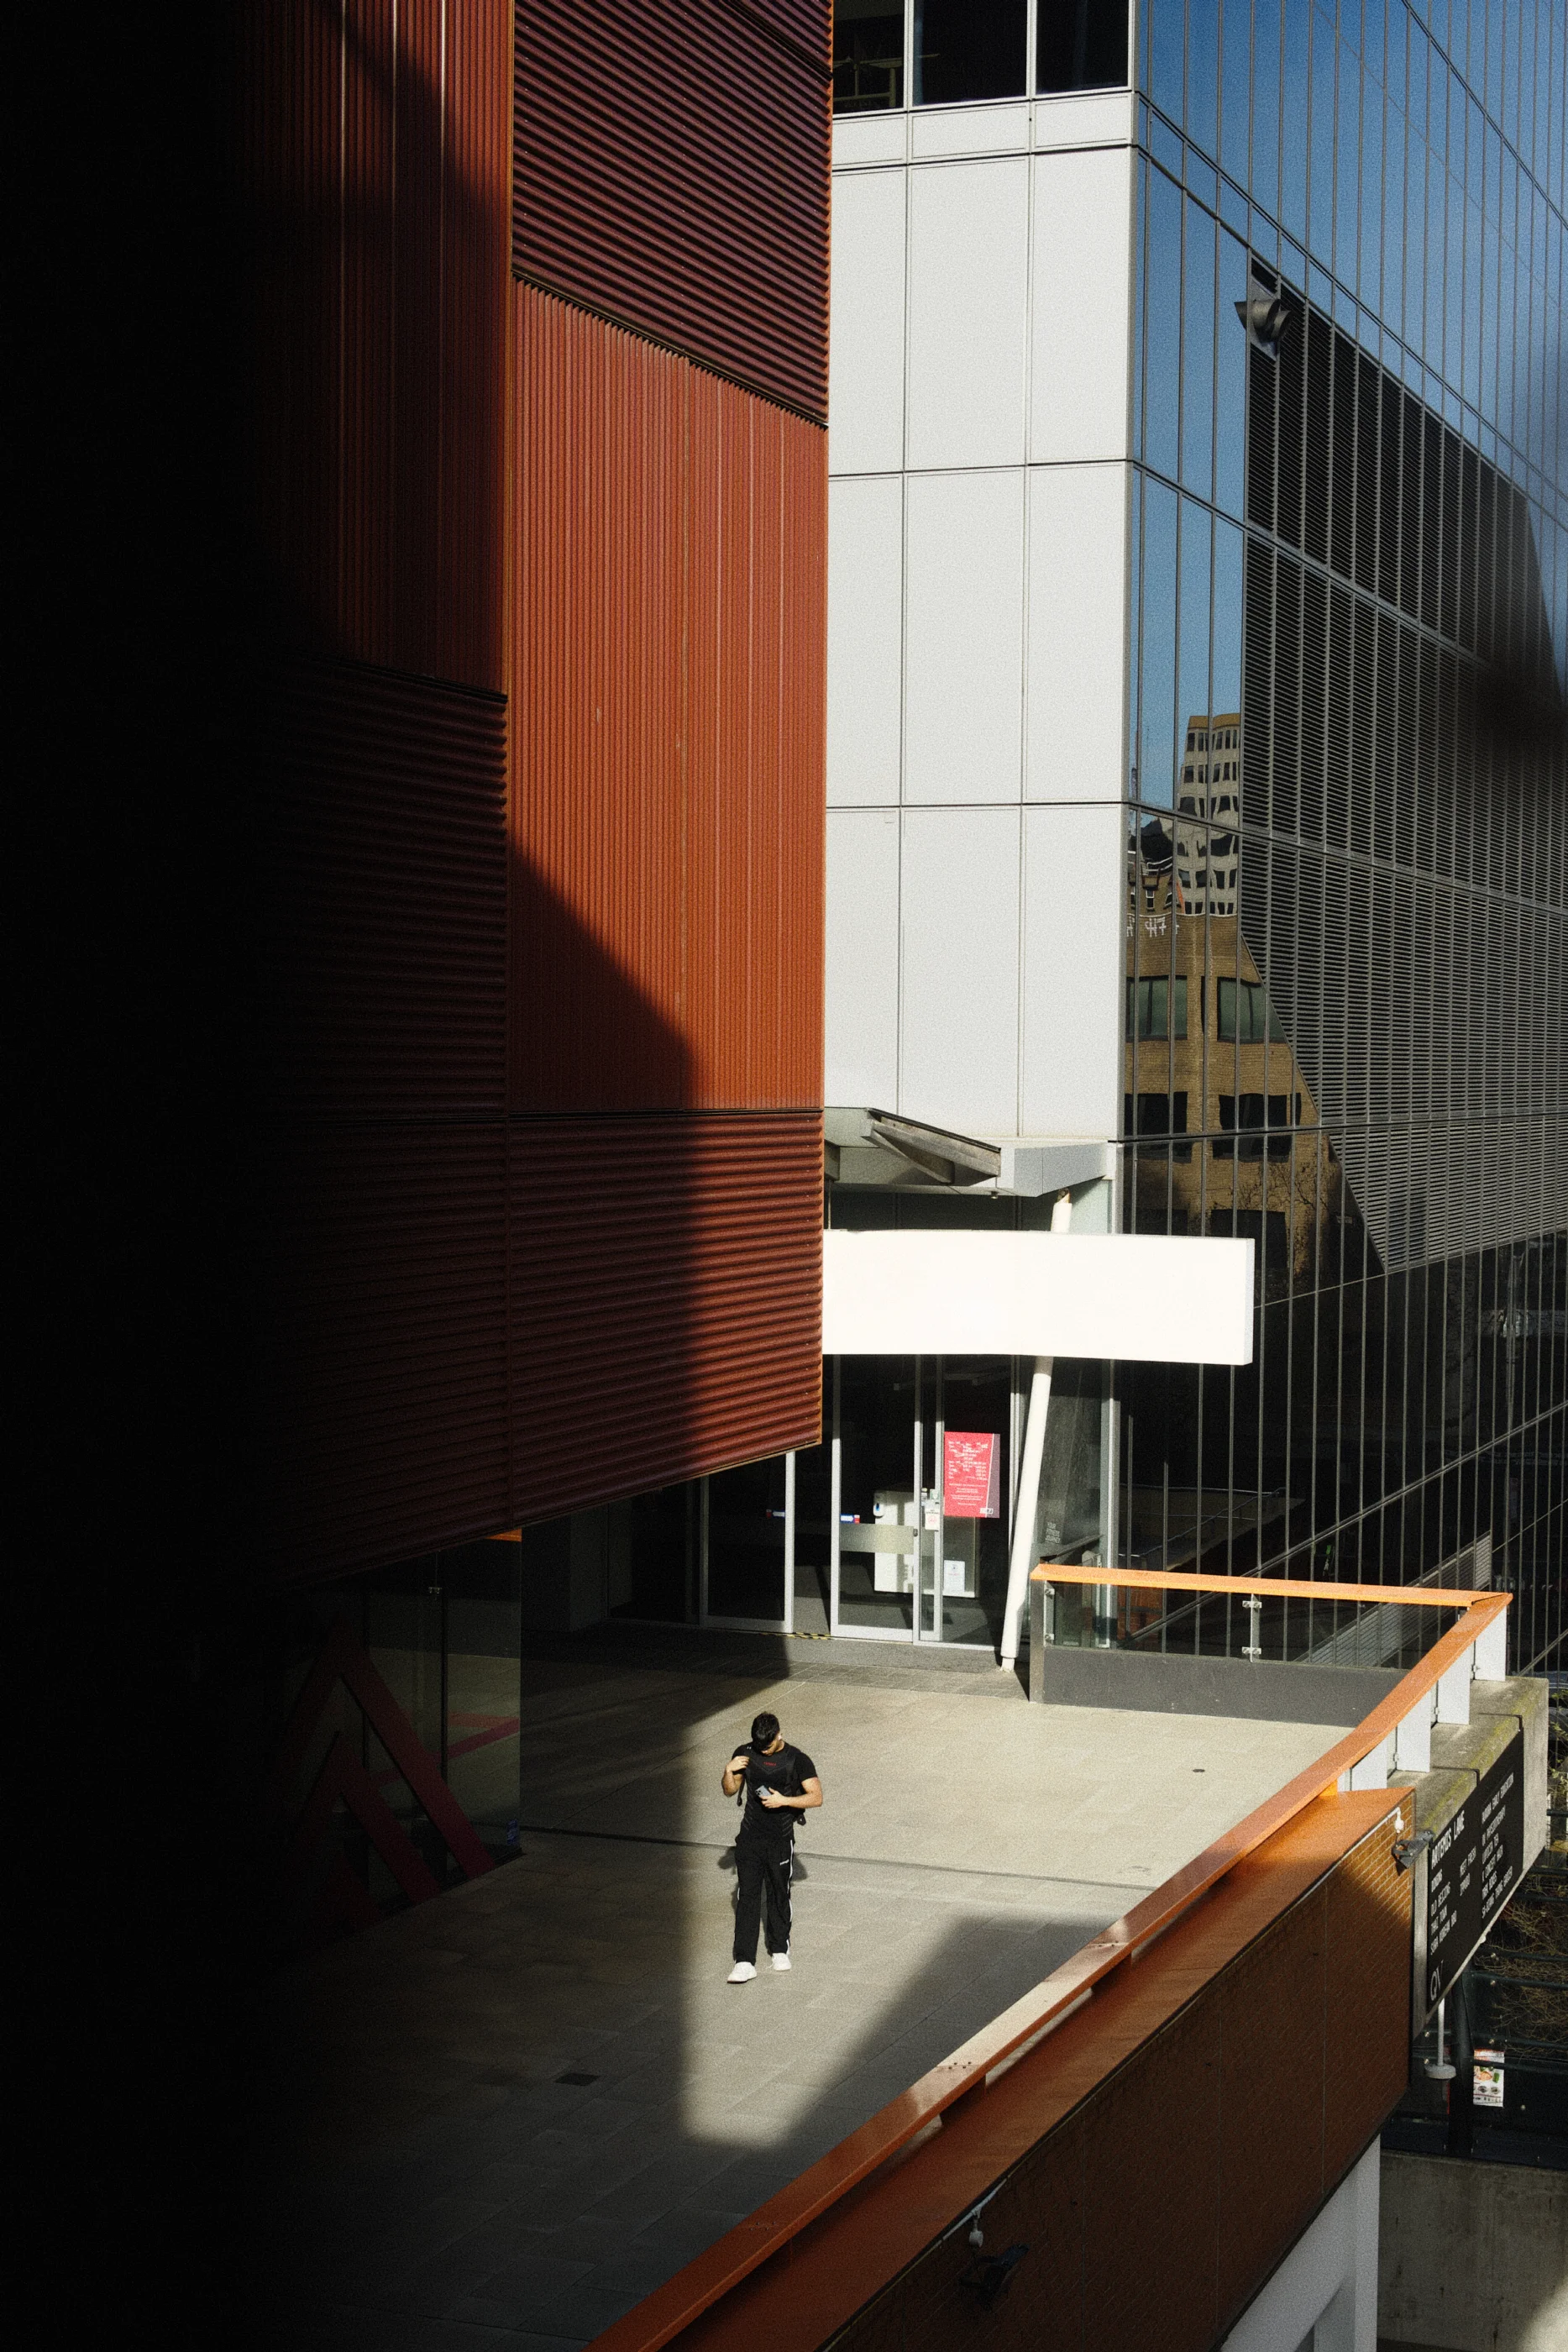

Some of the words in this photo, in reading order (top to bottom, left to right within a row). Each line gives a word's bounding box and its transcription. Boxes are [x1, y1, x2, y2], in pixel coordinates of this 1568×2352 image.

[1432, 1828, 1451, 1869] ARTEMIS
[1454, 1810, 1464, 1840] LANE
[1430, 1960, 1443, 2000] QV
